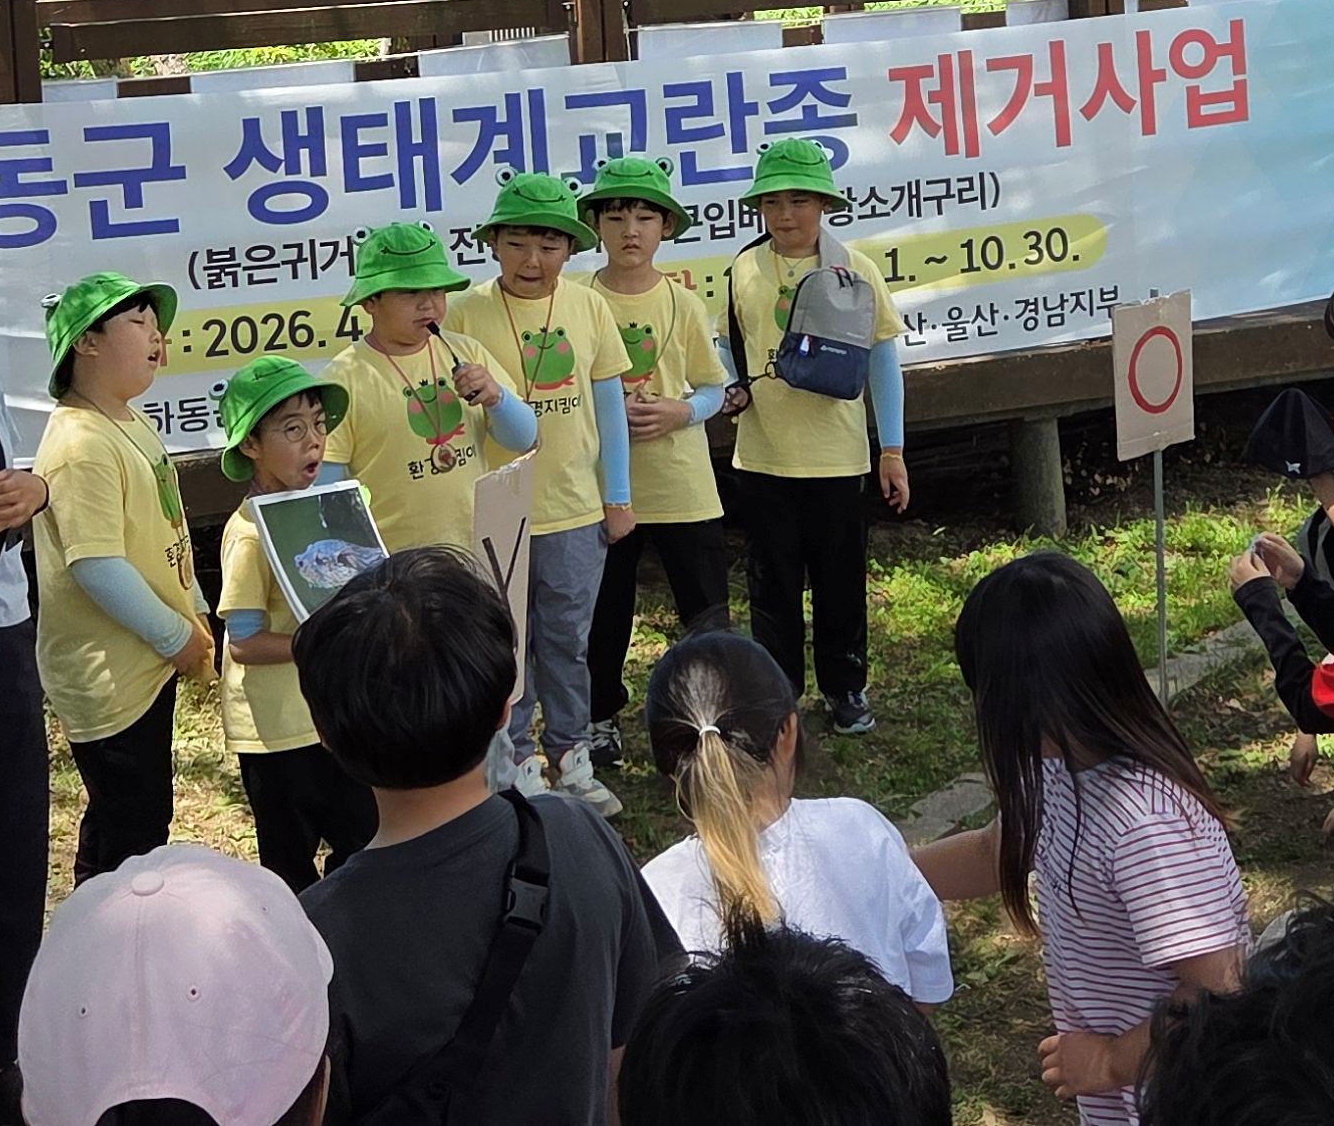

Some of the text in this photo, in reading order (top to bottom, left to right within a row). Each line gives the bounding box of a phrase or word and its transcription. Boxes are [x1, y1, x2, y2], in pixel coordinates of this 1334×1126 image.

[222, 67, 859, 225] 생태계교란종
[888, 18, 1250, 159] 제거사업
[188, 235, 357, 291] (붉은귀거
[142, 284, 1123, 435] 하동 산·울산·경남지부
[530, 393, 582, 419] 경지킴이
